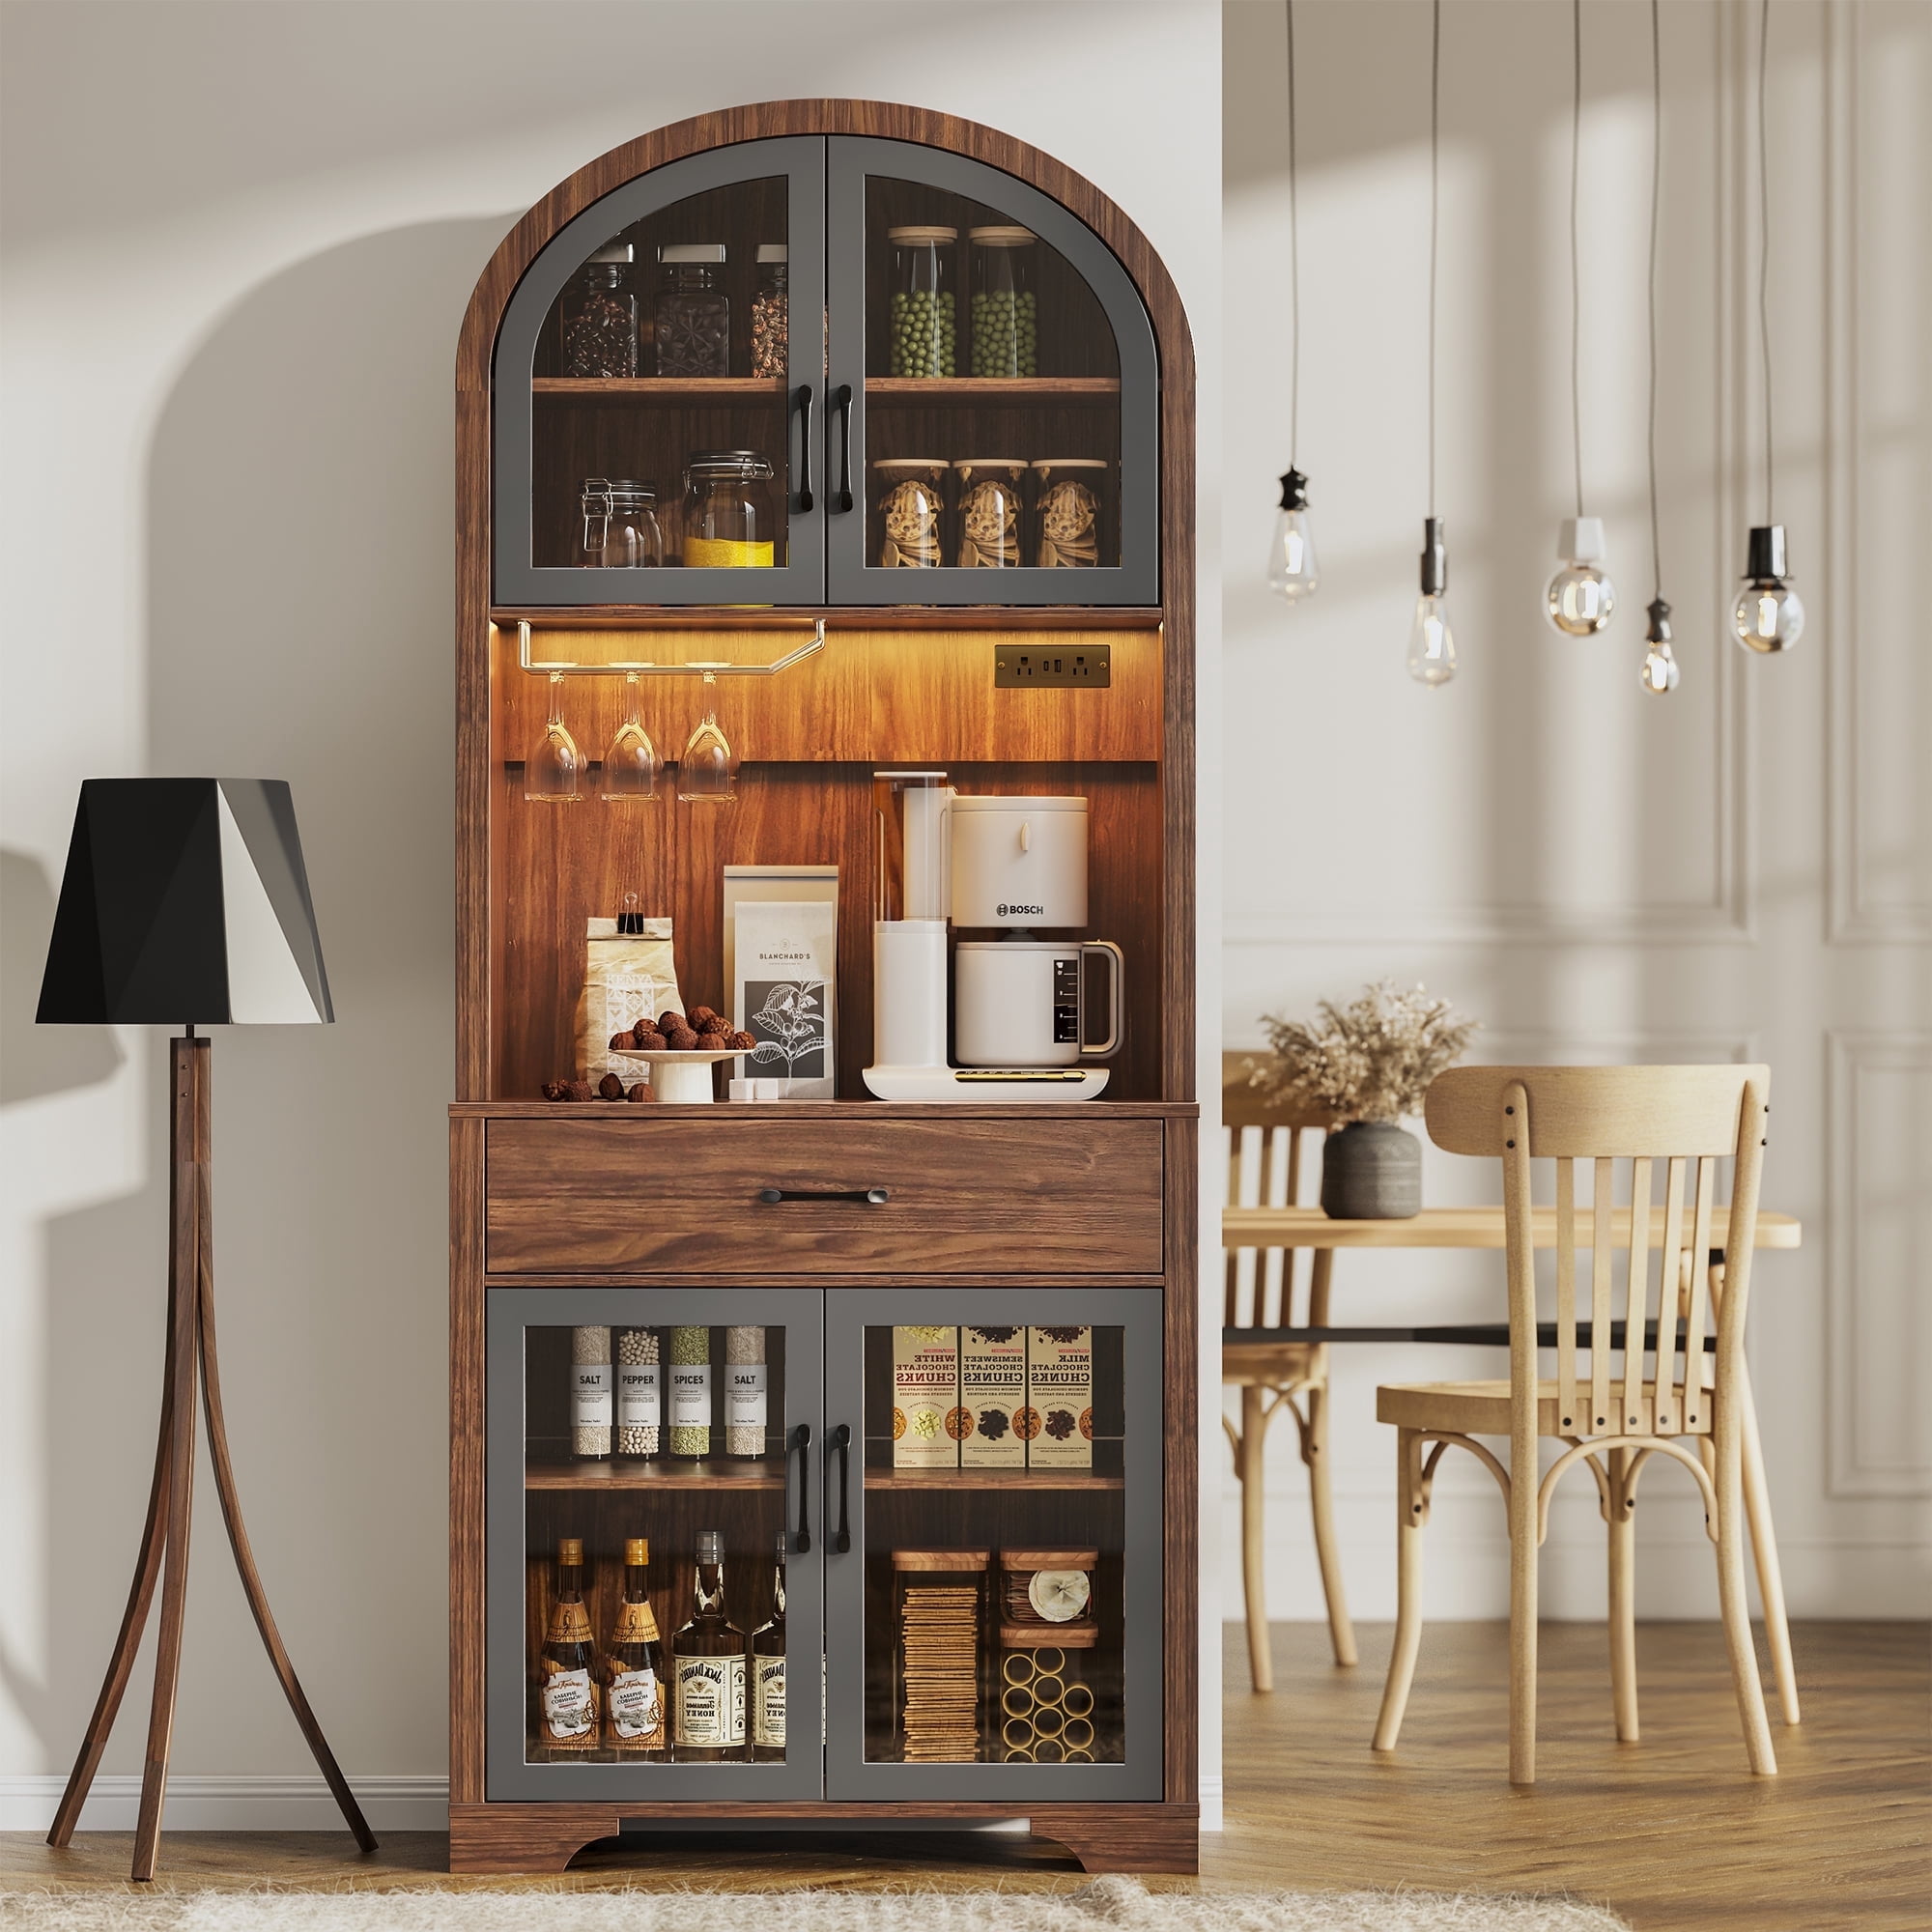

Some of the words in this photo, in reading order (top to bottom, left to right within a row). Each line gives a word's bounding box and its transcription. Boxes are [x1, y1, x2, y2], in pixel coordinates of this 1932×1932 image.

[1009, 904, 1043, 915] BOSCH
[607, 974, 654, 984] KENYA
[580, 1376, 601, 1384] SALT
[622, 1376, 654, 1384] PEPPER
[674, 1376, 703, 1384] SPICES
[734, 1376, 755, 1384] SALT
